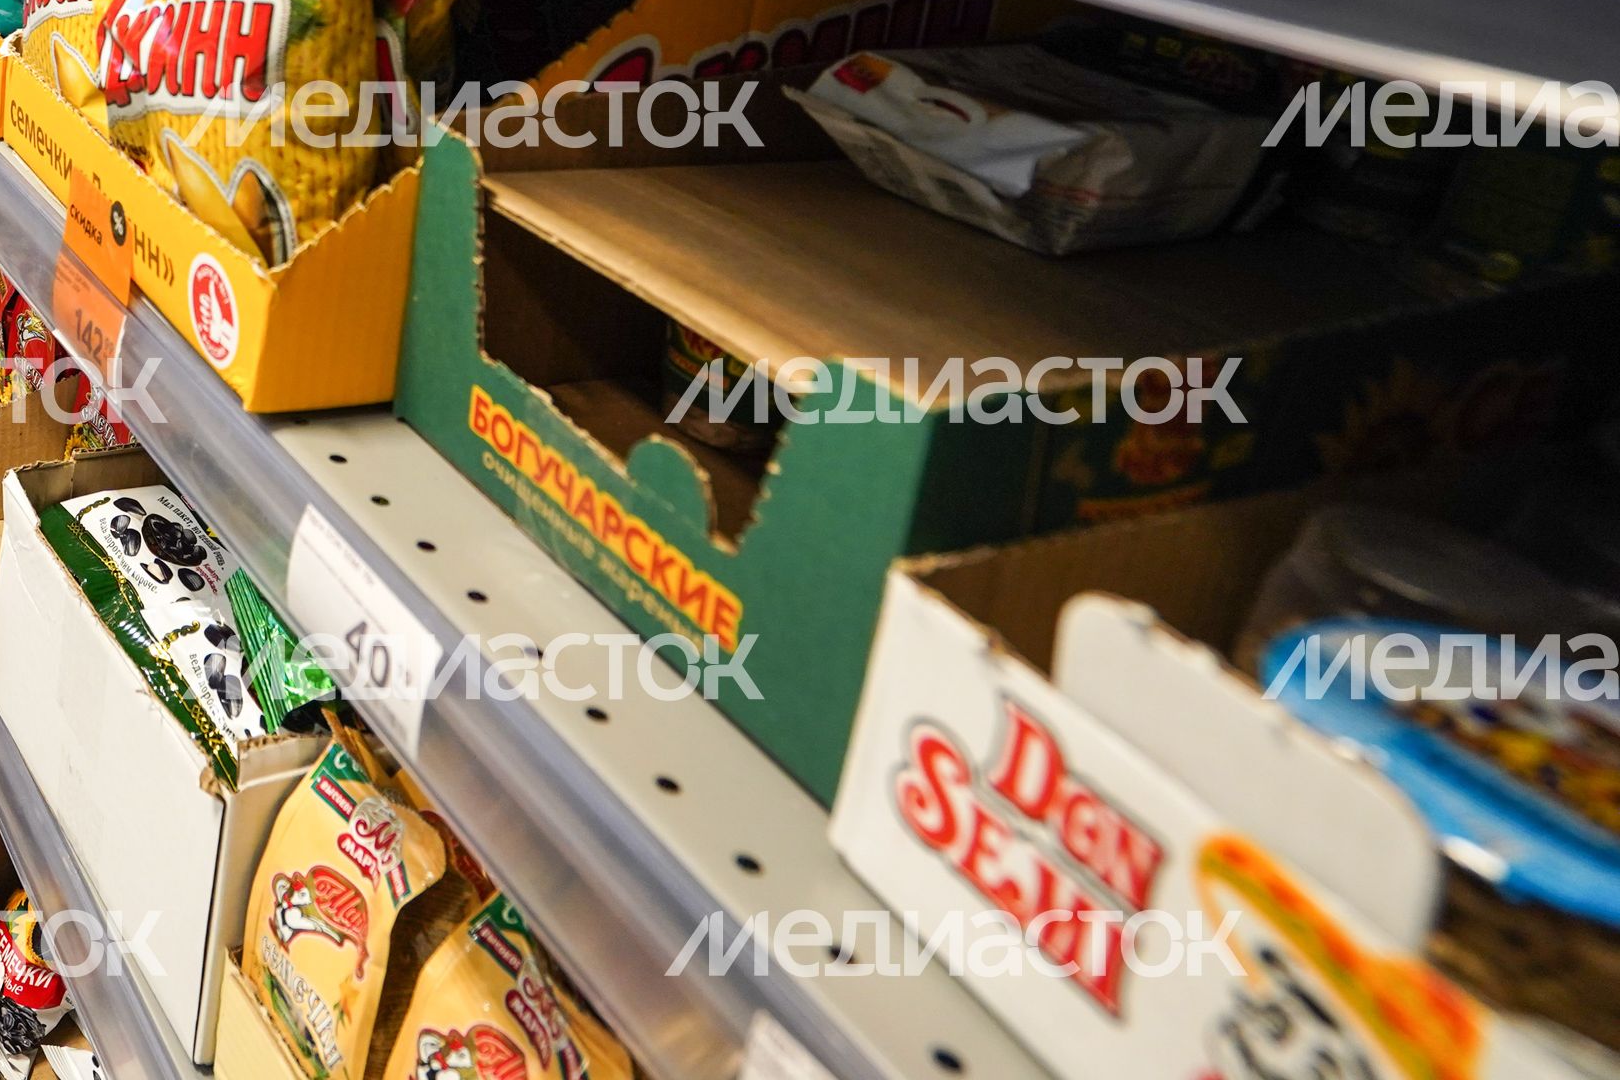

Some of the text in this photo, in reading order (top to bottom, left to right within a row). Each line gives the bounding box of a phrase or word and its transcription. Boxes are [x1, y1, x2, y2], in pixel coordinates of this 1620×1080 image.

[10, 98, 74, 182] семечки
[69, 203, 103, 248] скидка
[74, 308, 104, 366] 142
[157, 495, 175, 512] Мал
[172, 506, 192, 528] пакет,
[471, 388, 741, 652] БОГУЧАРСКИЕ
